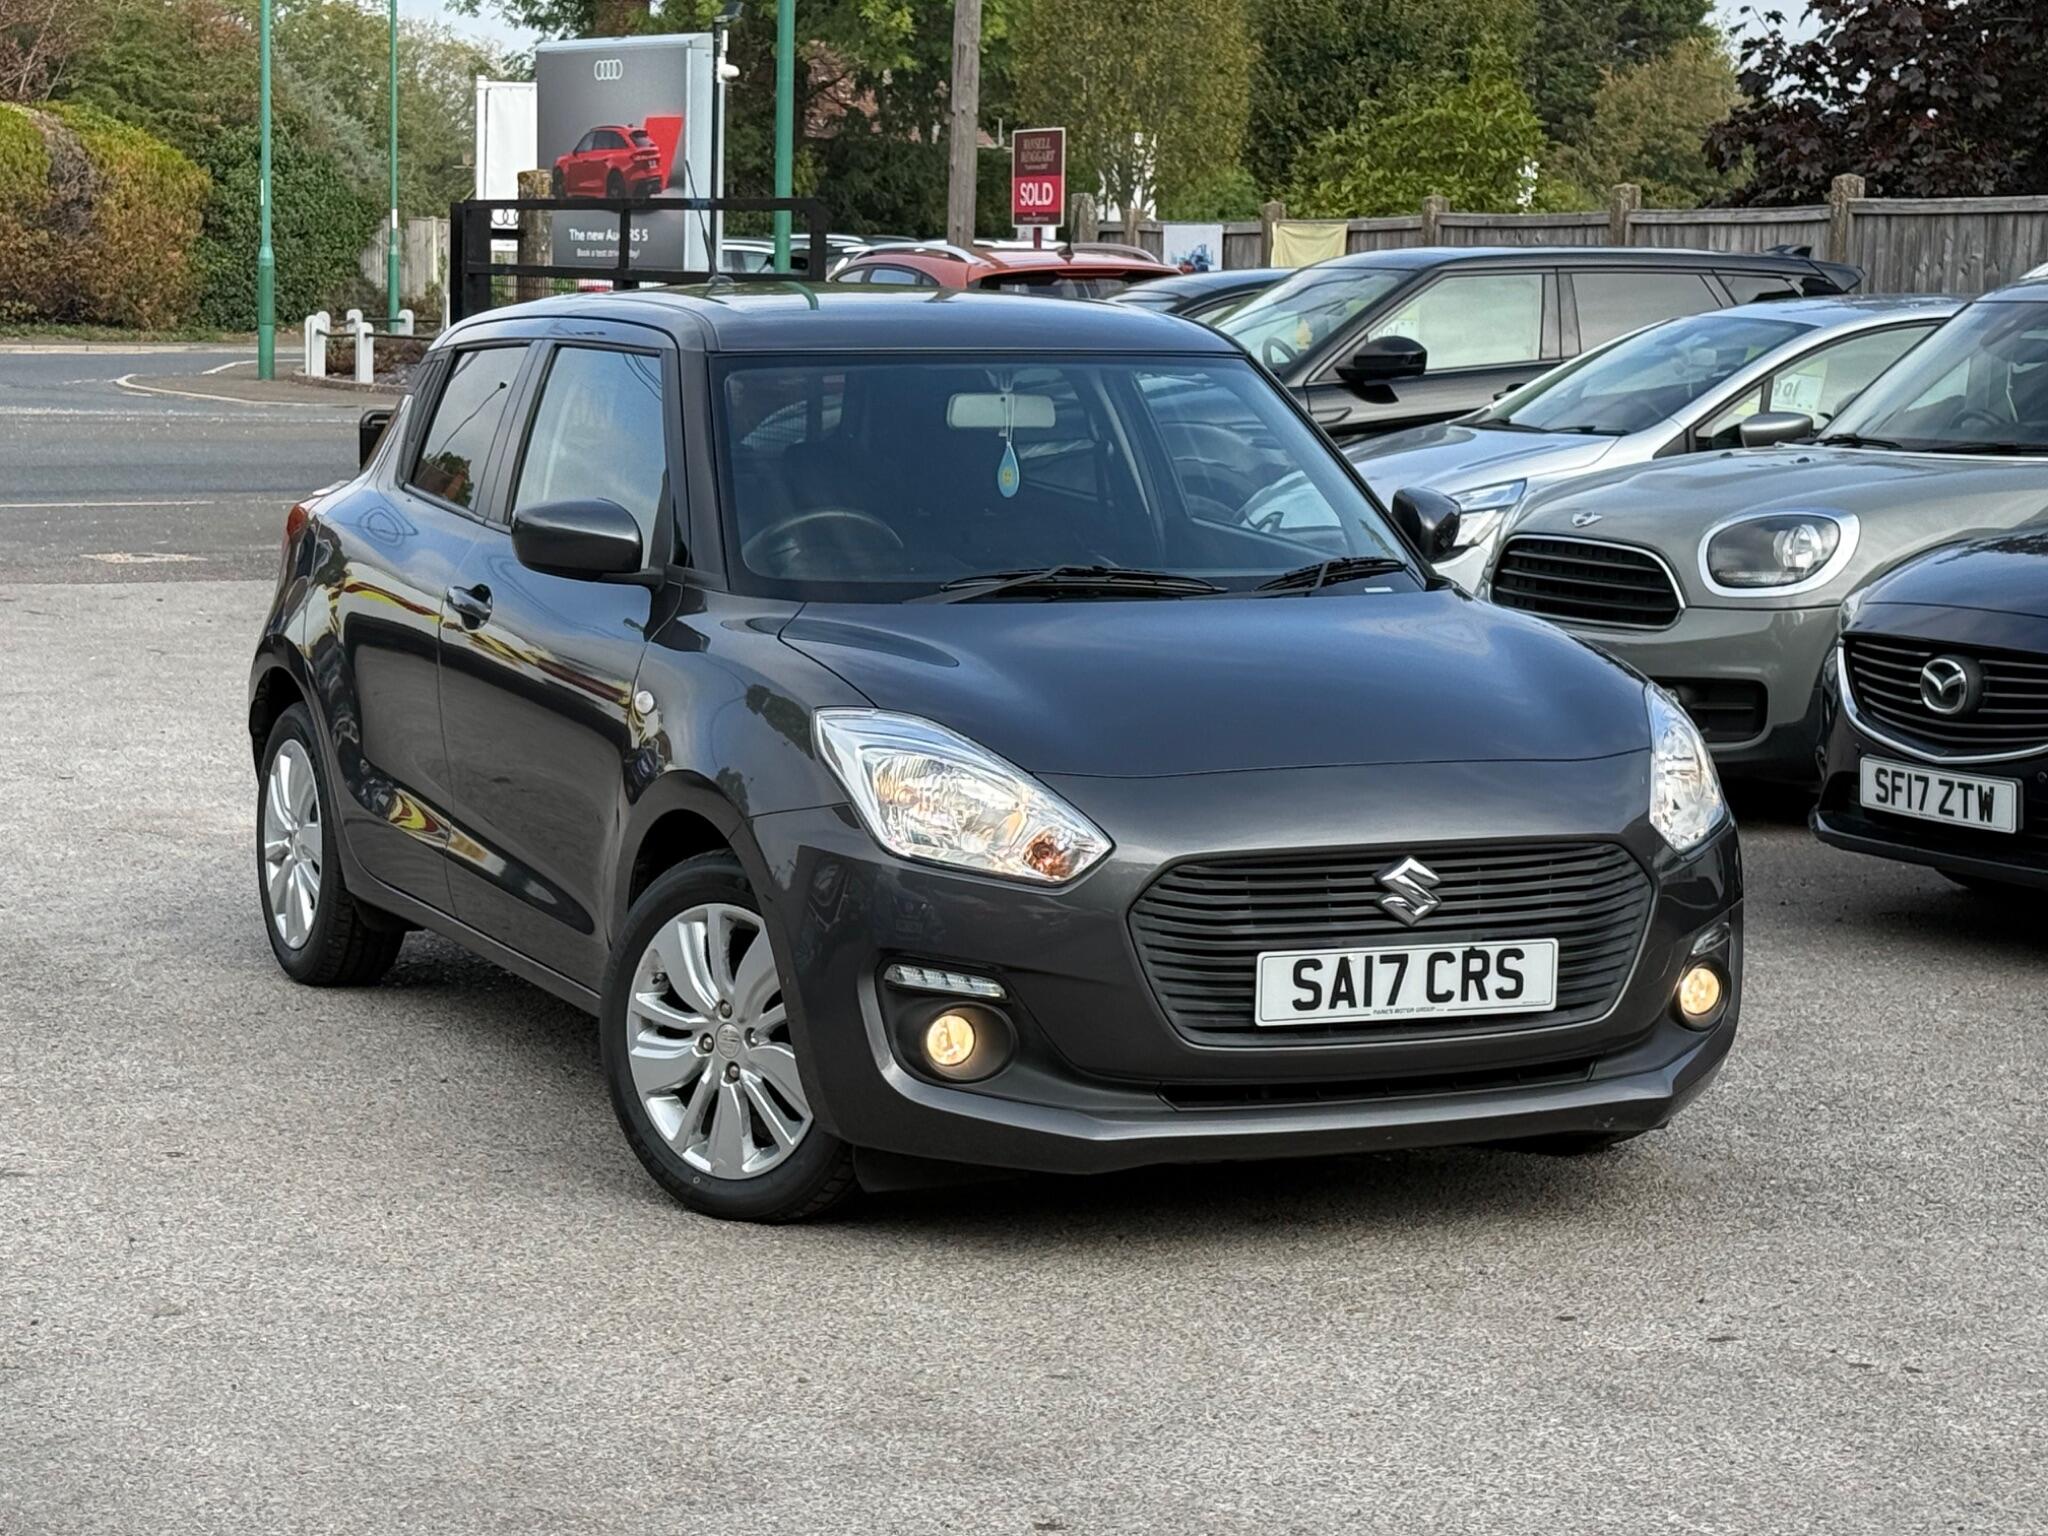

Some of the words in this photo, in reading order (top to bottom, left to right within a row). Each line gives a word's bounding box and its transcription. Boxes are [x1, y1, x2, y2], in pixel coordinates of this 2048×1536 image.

[1020, 182, 1053, 206] SOLD
[568, 228, 585, 241] The
[586, 231, 605, 241] new
[606, 228, 620, 241] Au
[1875, 767, 1930, 811] SF17
[1938, 779, 1995, 823] ZTW
[1292, 954, 1409, 1011] SA17
[1426, 947, 1525, 1004] CRS
